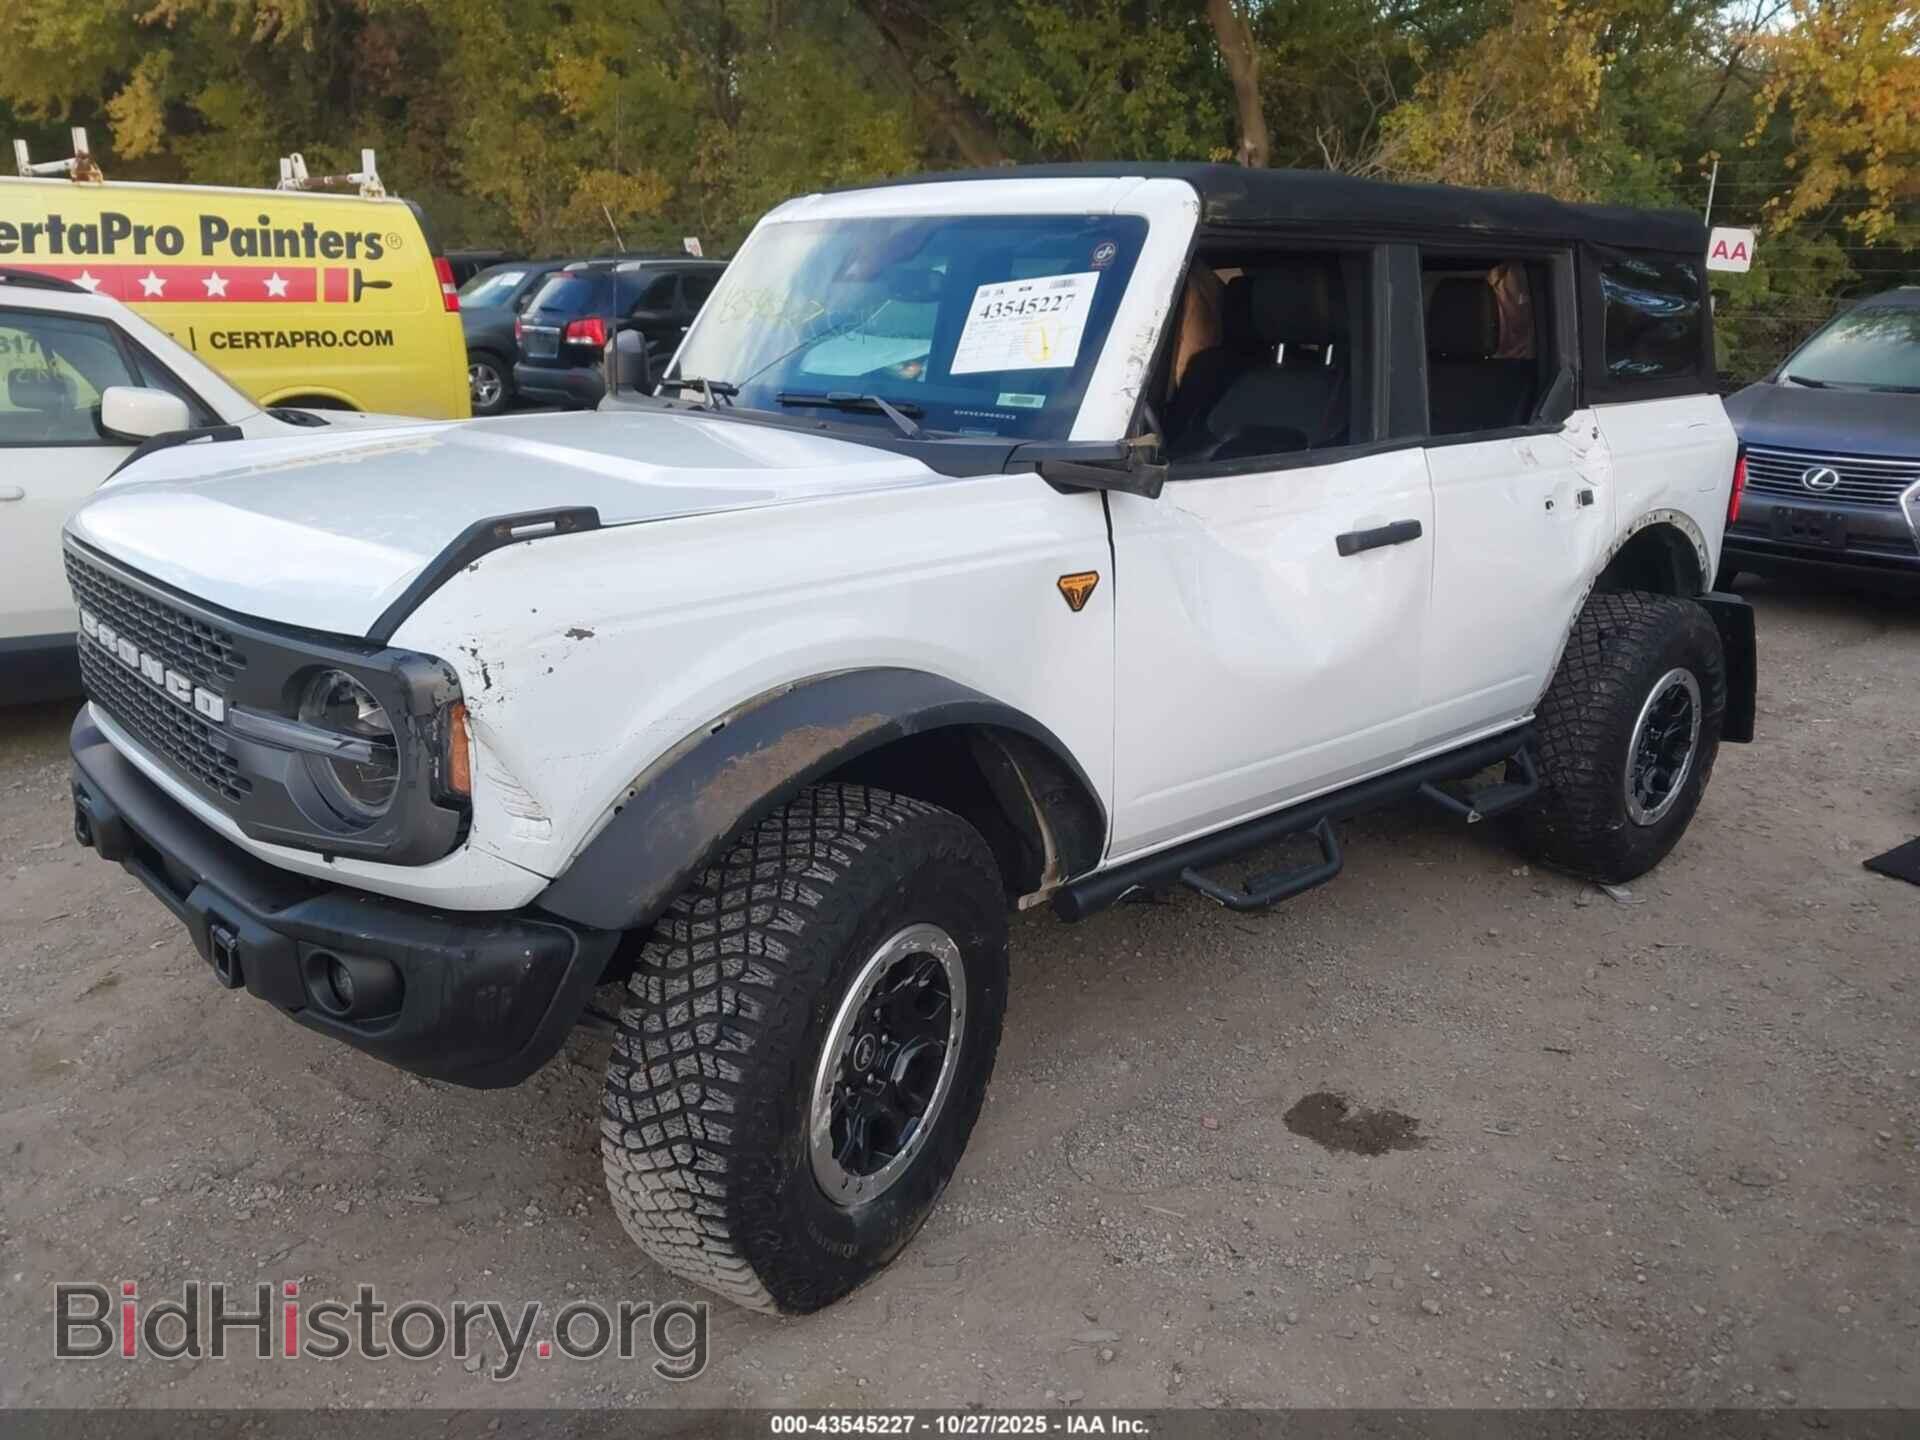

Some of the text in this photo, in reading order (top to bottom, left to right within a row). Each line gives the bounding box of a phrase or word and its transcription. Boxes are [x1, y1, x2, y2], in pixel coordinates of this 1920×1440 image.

[1712, 240, 1747, 260] AA
[980, 294, 1075, 319] 43545227
[210, 330, 394, 349] CERTAPRO.COM
